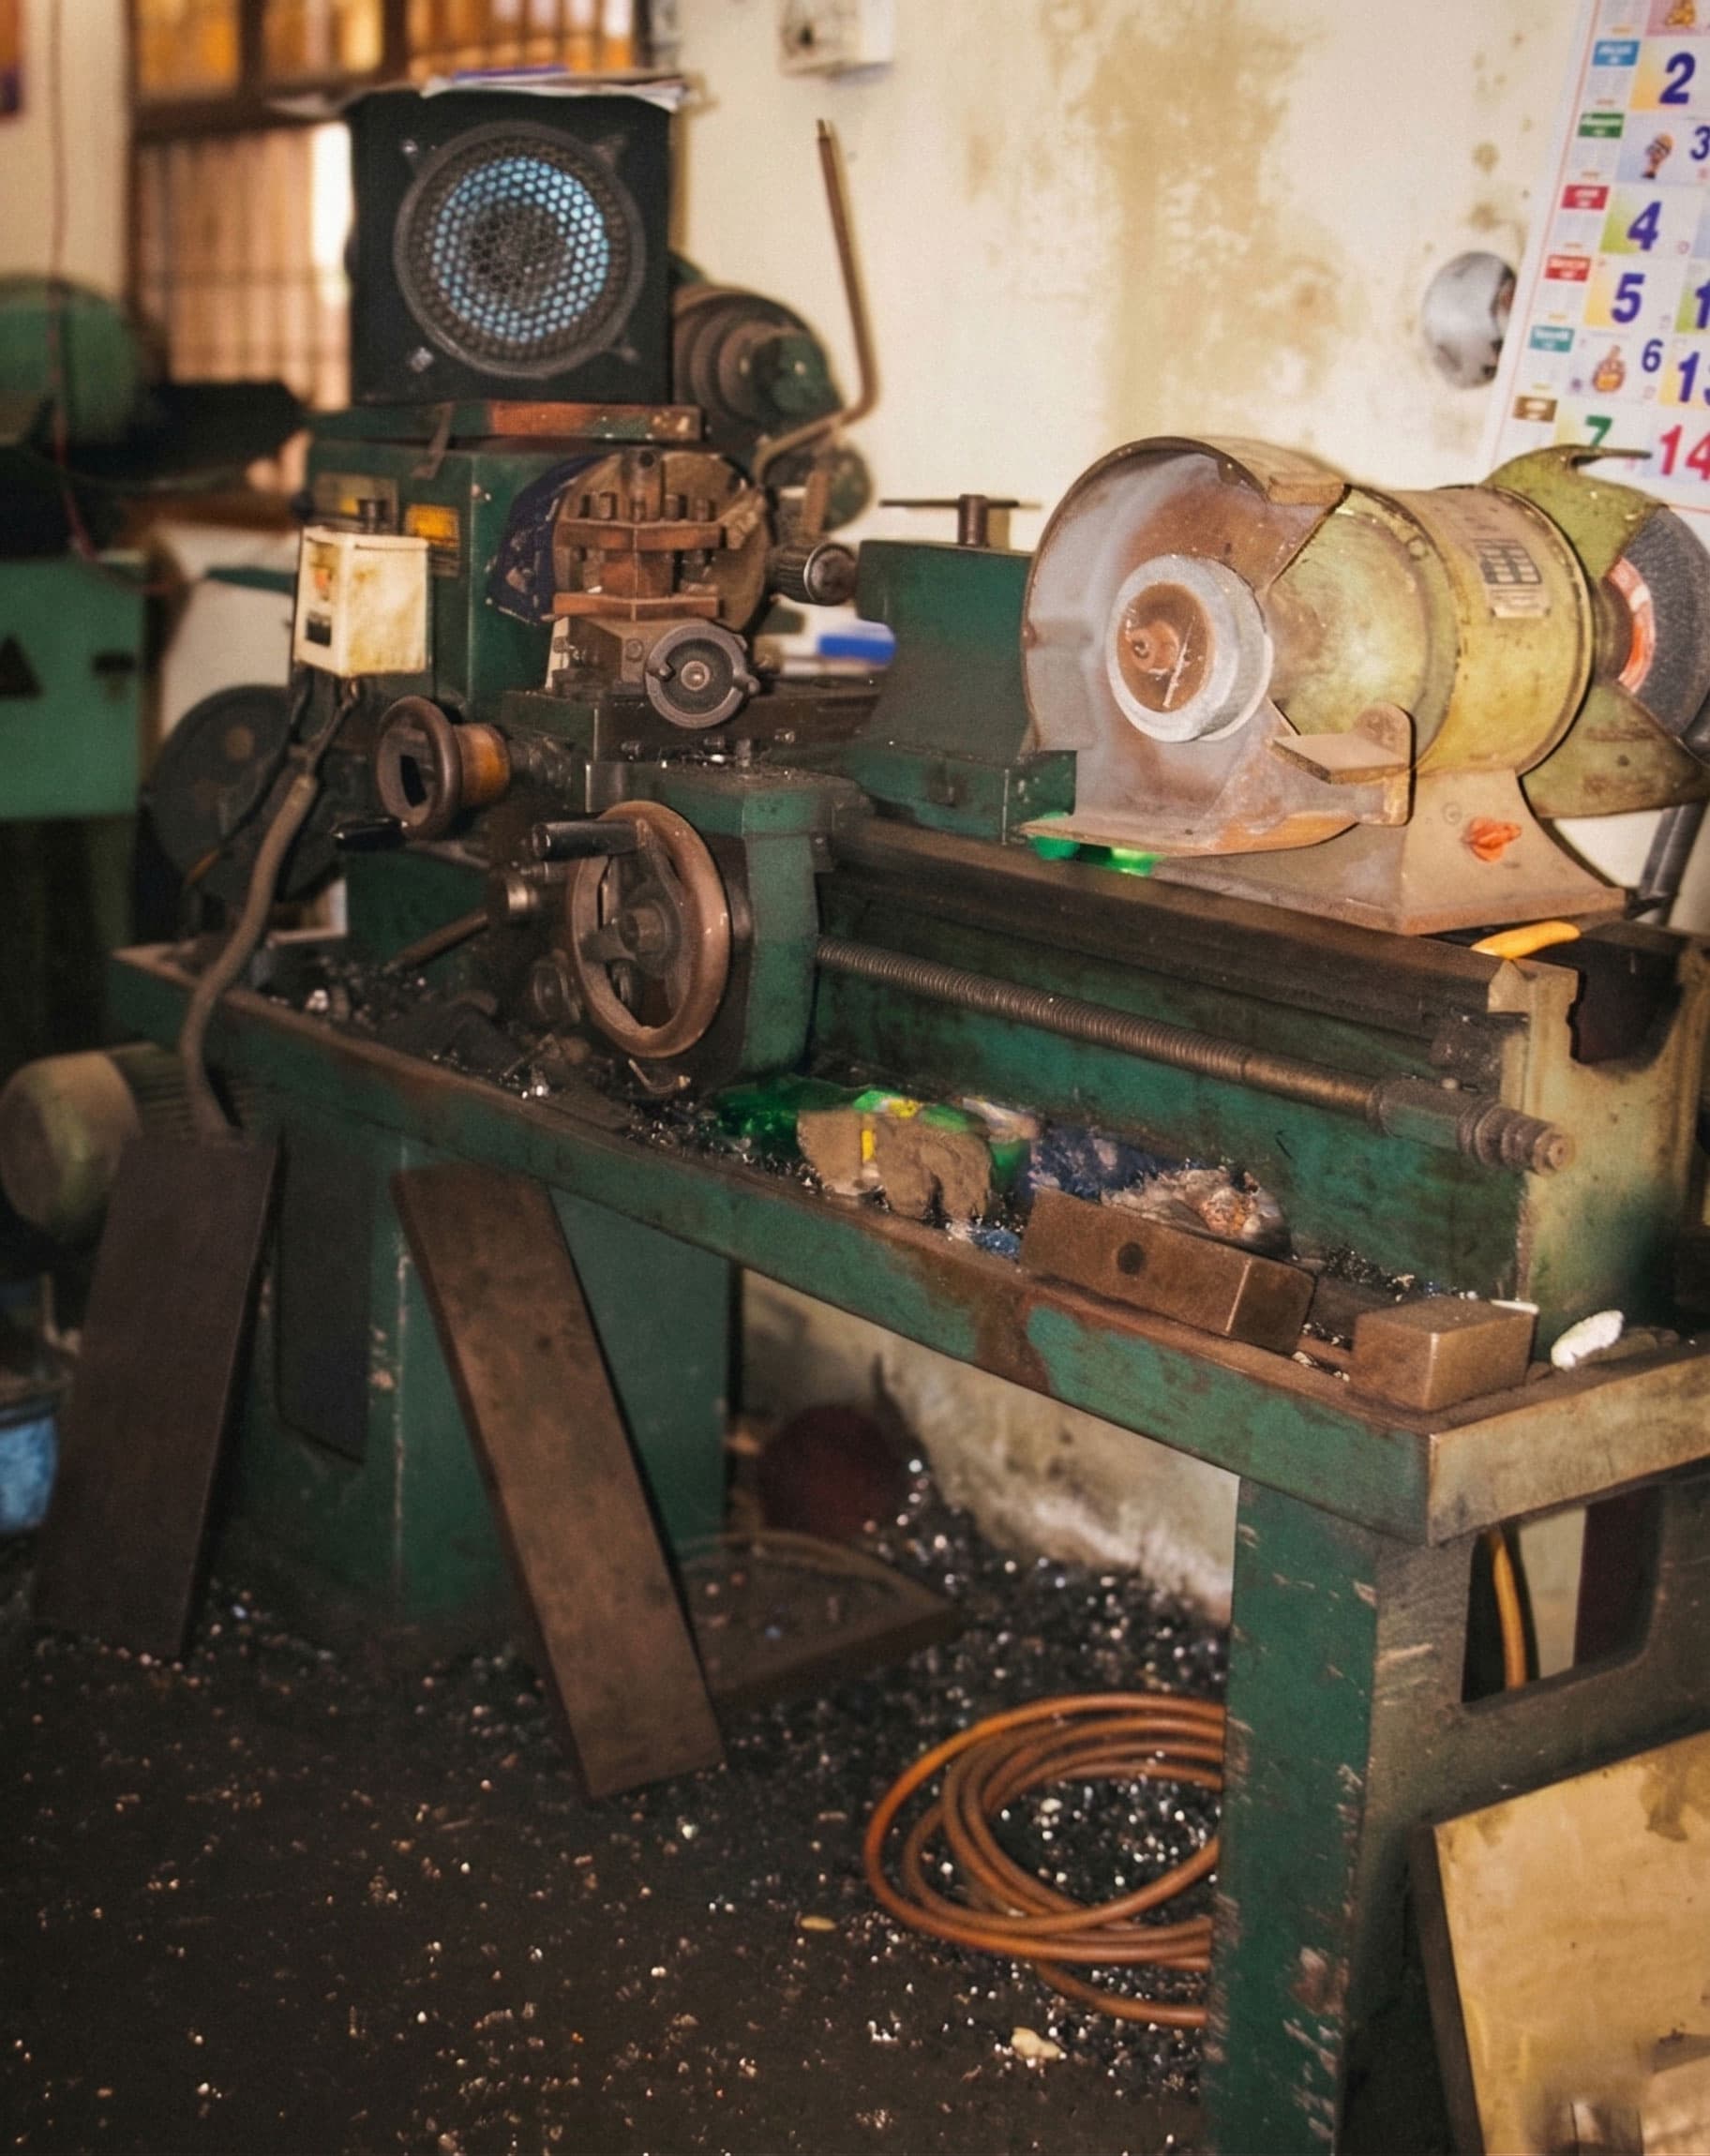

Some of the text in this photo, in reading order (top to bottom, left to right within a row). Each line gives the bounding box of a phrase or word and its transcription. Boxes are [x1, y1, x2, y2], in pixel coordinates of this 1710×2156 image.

[1658, 52, 1696, 104] 2
[1690, 125, 1710, 161] 3
[1627, 201, 1662, 251] 4
[1611, 272, 1645, 323] 5
[1642, 338, 1664, 373] 6
[1678, 352, 1710, 406] 1
[1584, 414, 1612, 446] 7
[1658, 425, 1710, 481] 14
